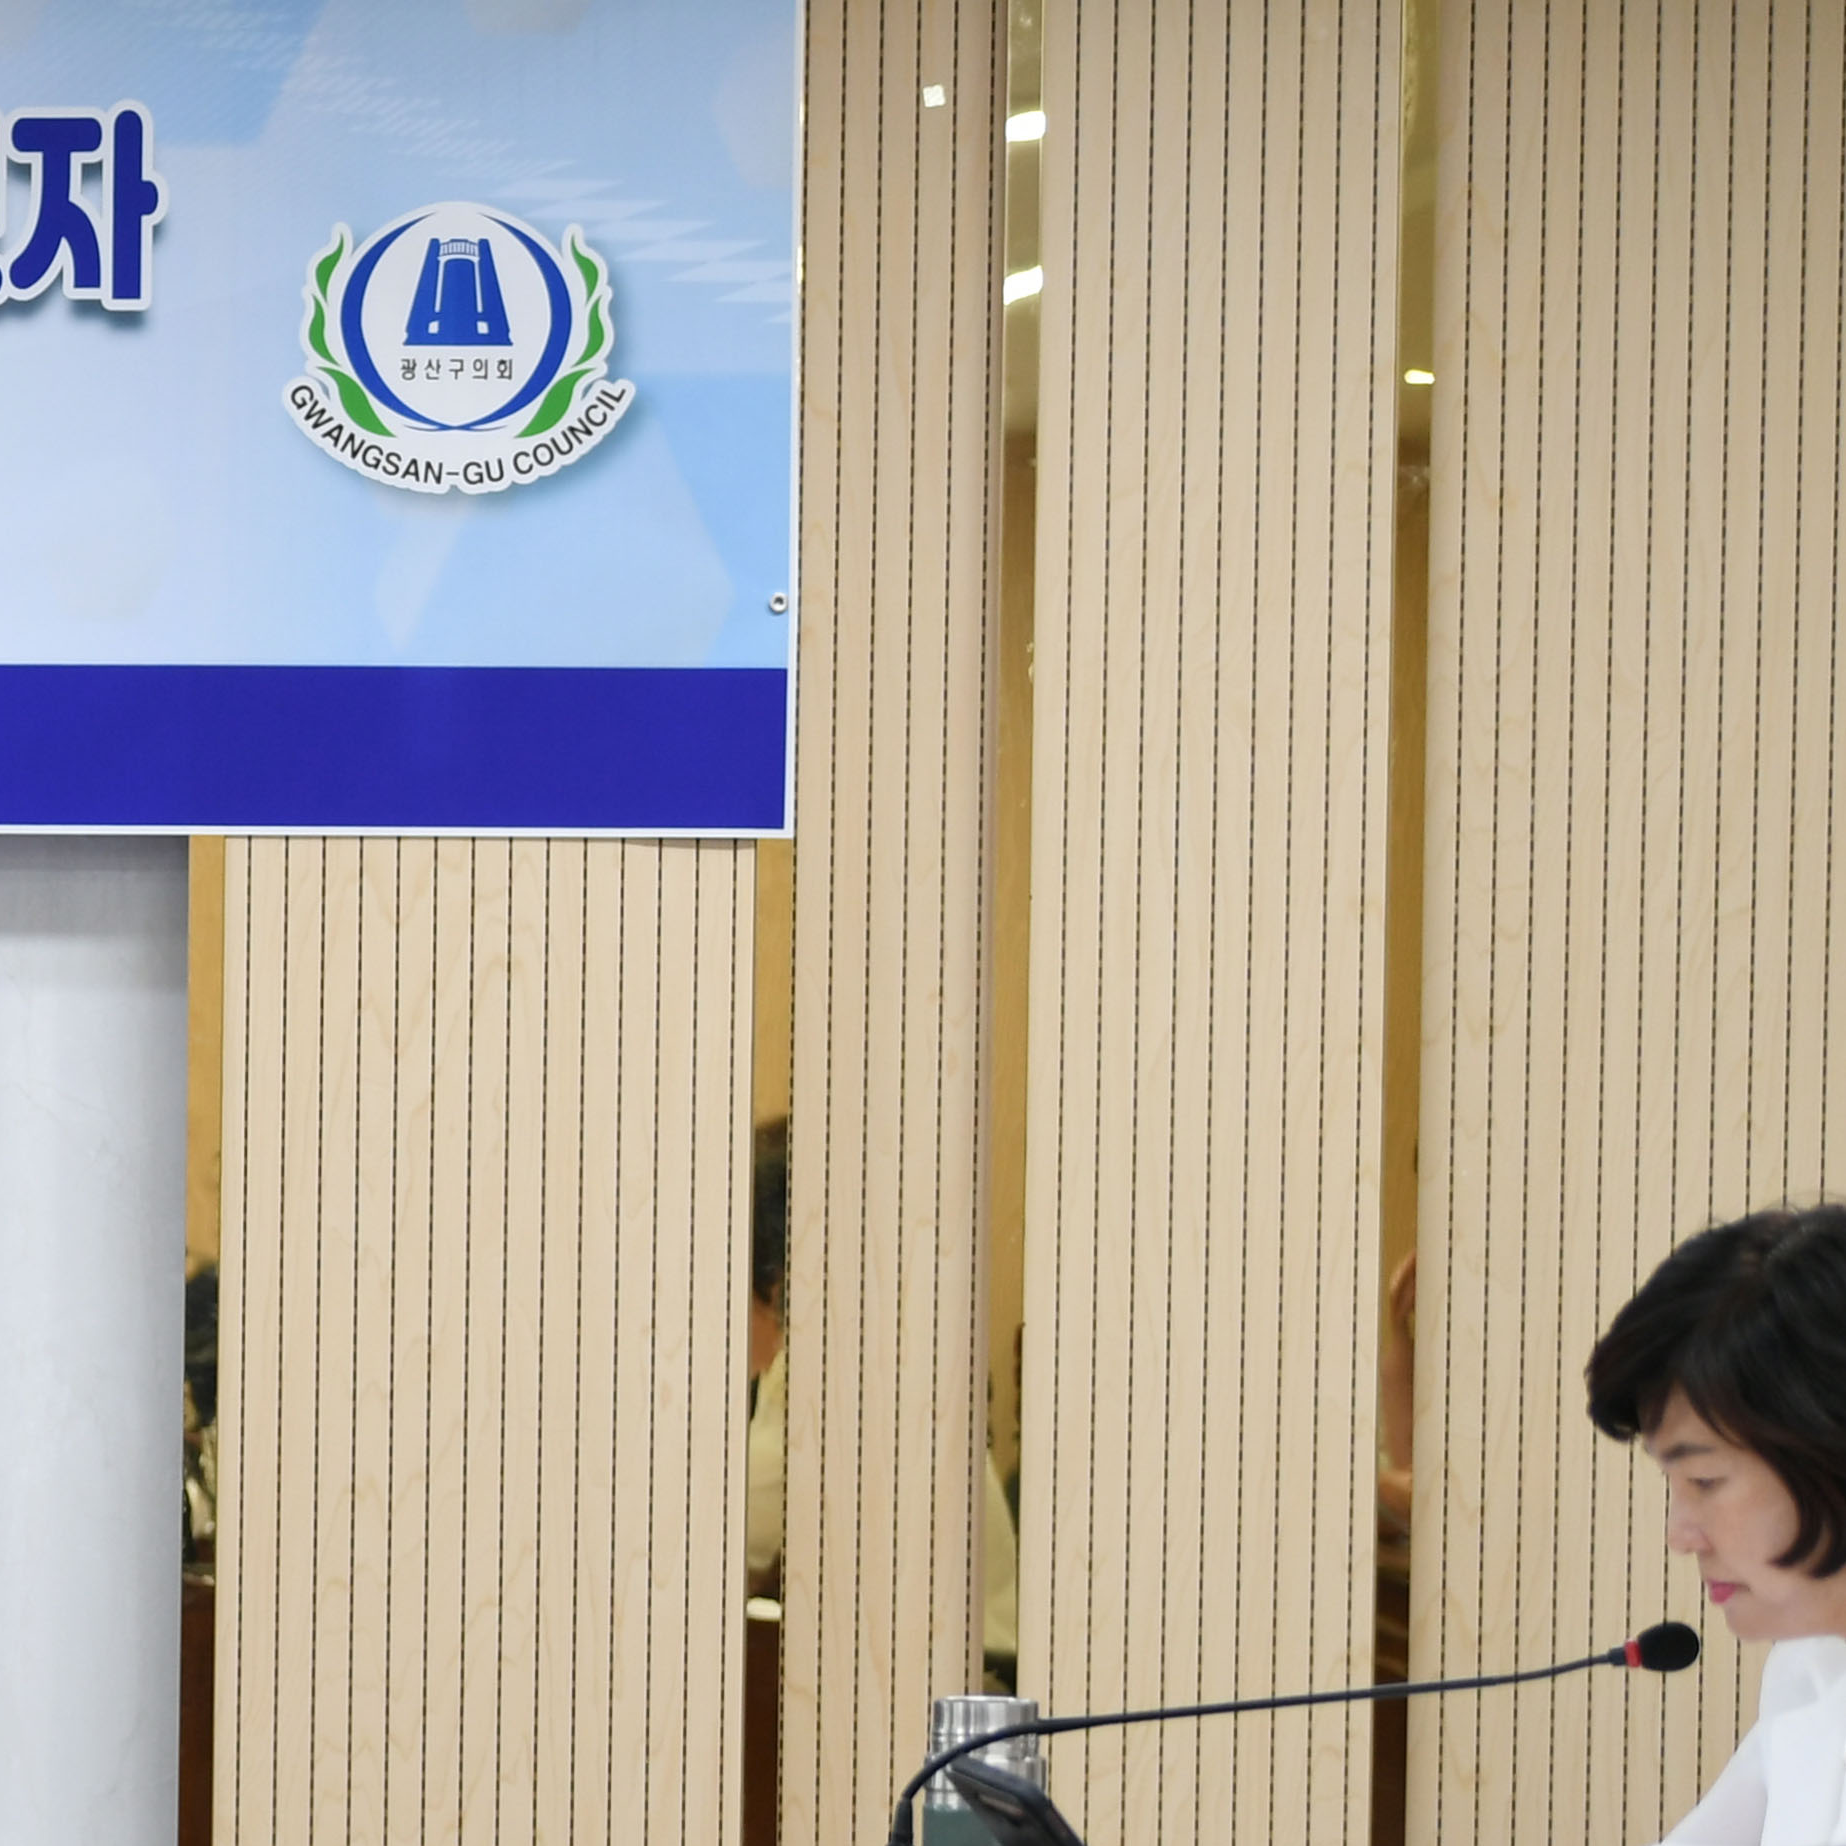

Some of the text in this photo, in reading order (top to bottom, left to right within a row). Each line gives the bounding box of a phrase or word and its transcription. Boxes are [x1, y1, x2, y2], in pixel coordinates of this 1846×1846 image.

[400, 358, 514, 381] 광산구의회
[290, 384, 626, 486] GWANGSAN-GU COUNCIL
